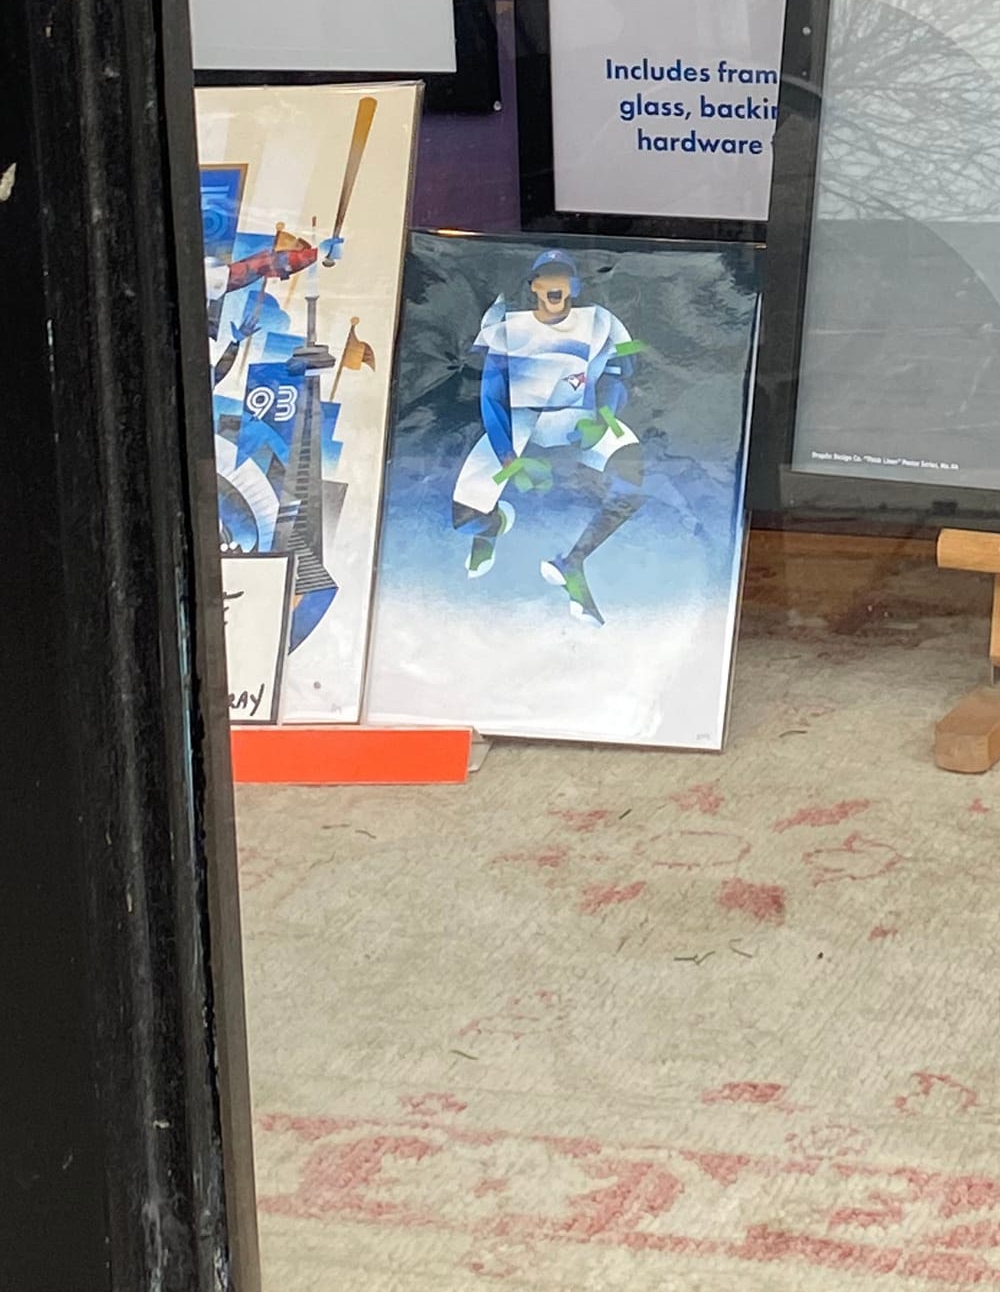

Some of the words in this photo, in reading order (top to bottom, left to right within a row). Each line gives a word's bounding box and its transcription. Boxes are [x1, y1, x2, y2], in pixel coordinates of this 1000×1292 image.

[605, 59, 710, 83] Includes
[717, 61, 778, 83] fram
[619, 93, 692, 121] glass,
[637, 129, 763, 155] hardware
[246, 386, 298, 421] 93
